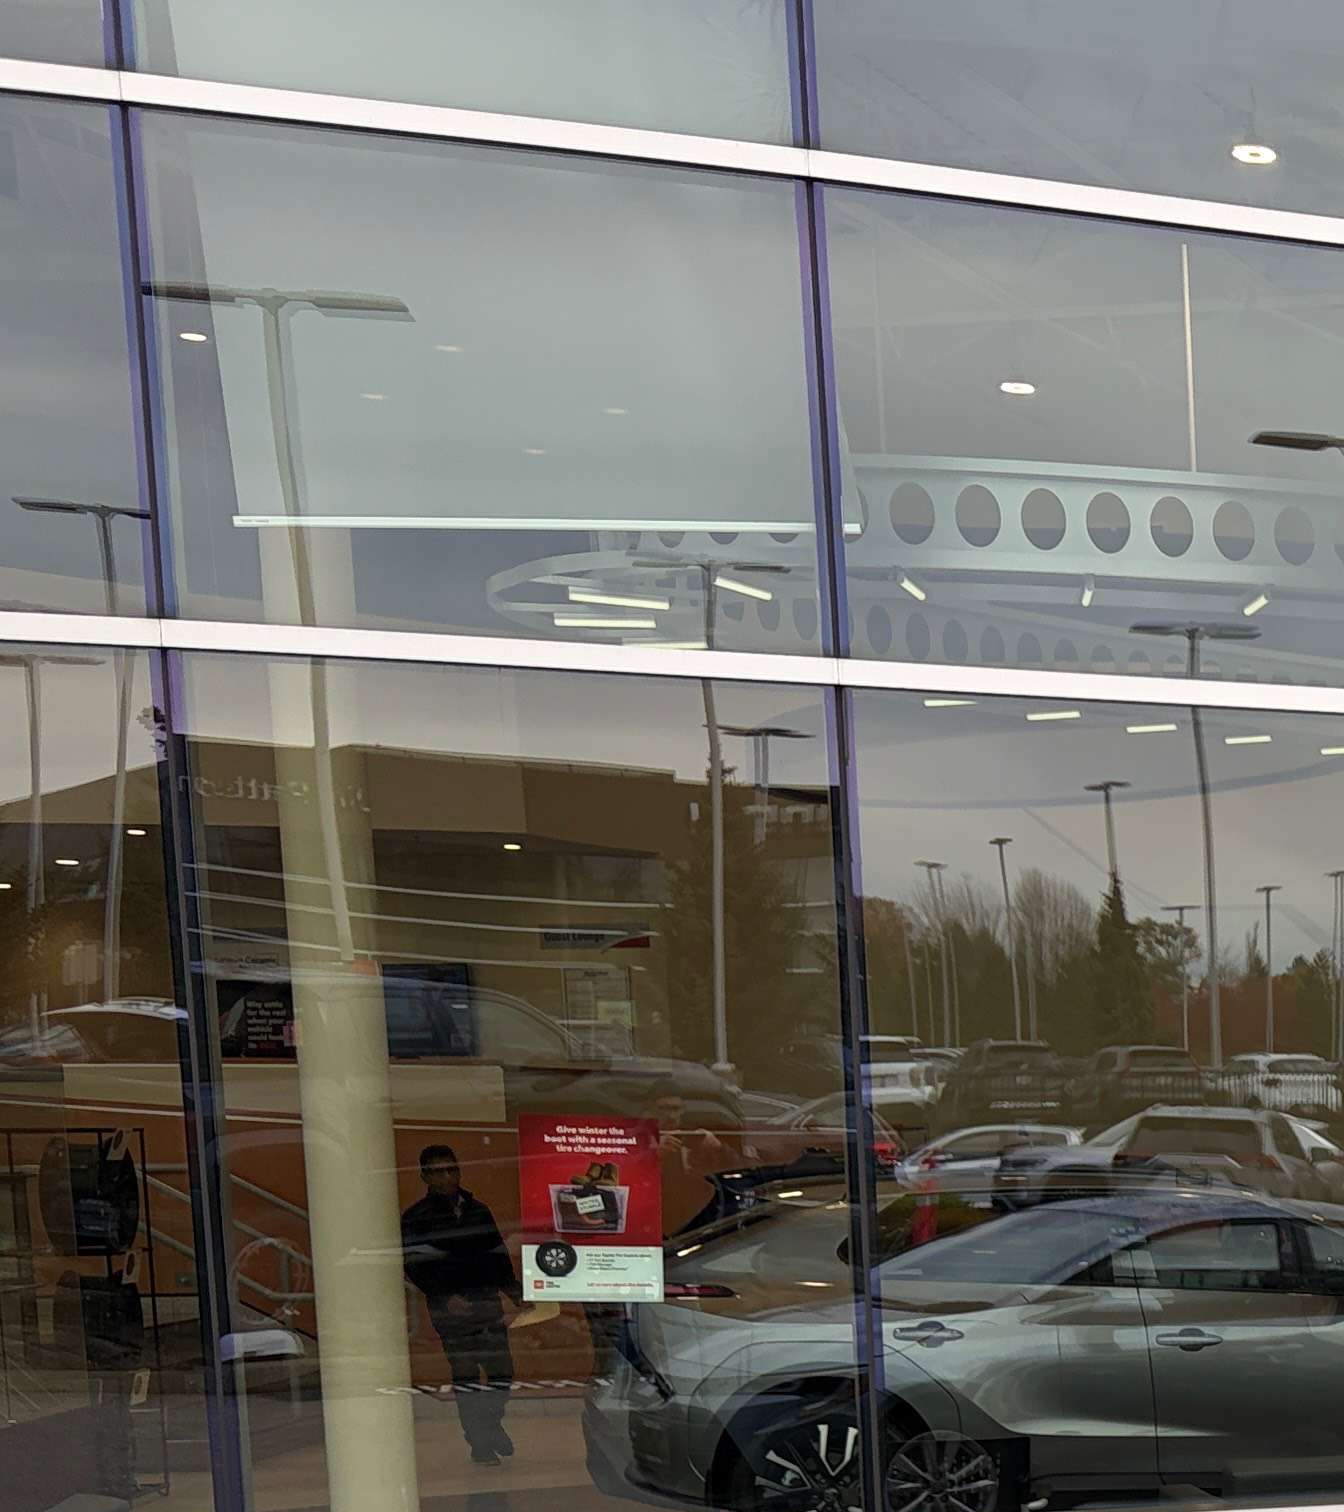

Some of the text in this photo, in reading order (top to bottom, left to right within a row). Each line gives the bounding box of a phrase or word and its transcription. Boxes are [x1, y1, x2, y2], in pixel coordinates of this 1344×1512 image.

[556, 1125, 625, 1135] Give winter the
[544, 1134, 567, 1143] boot
[568, 1135, 589, 1144] with
[597, 1137, 637, 1145] seasonal
[556, 1144, 629, 1155] tire changeover.
